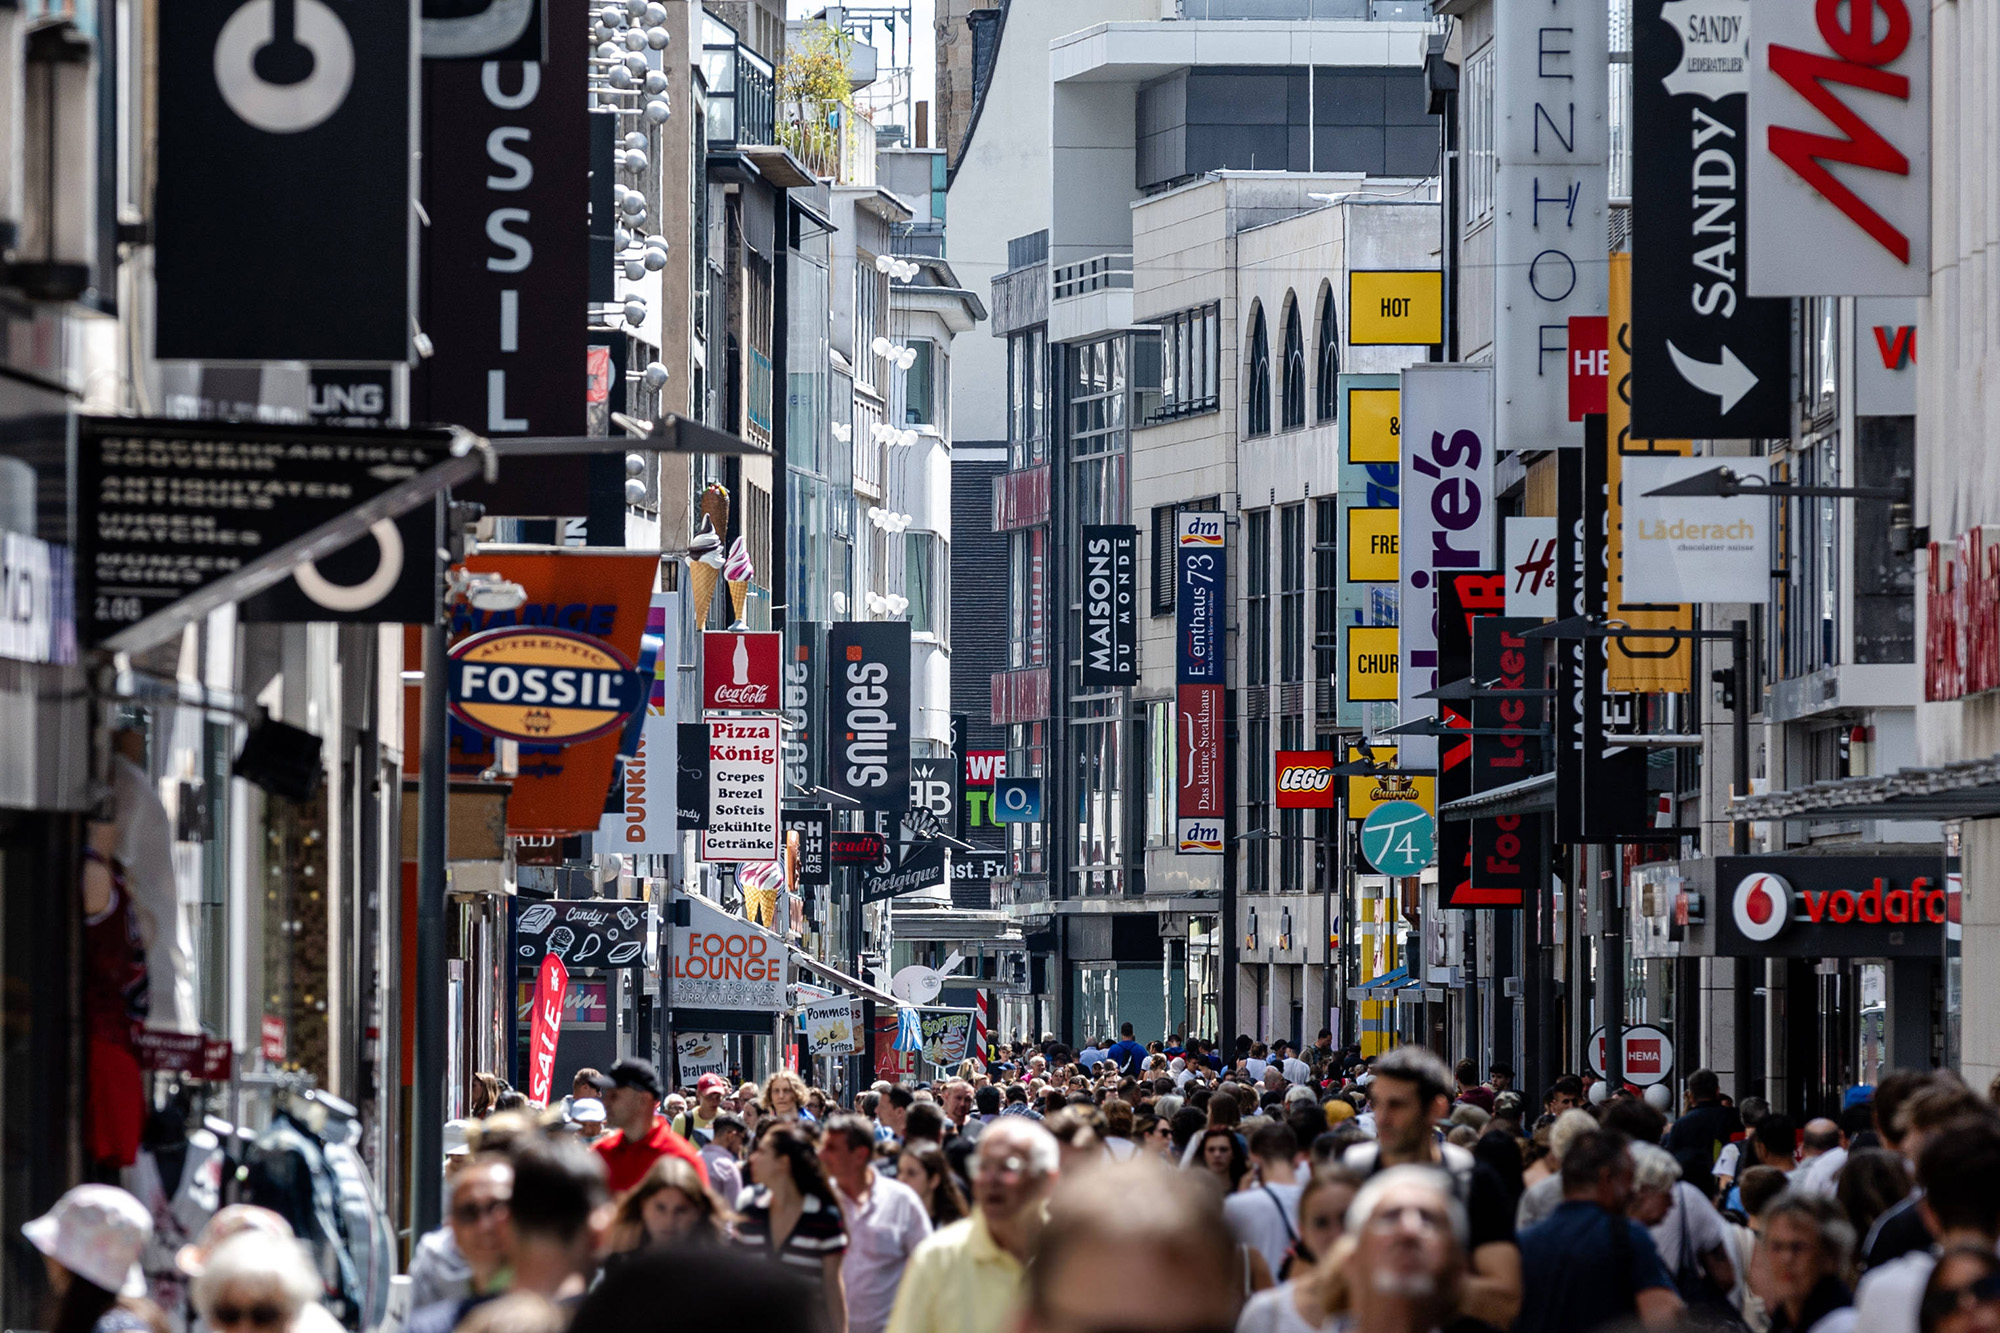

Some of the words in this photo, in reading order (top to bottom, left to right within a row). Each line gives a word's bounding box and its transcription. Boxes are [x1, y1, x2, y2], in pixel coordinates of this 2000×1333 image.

[1688, 14, 1742, 43] SANDY
[1687, 57, 1744, 73] LEDERATELIER
[1529, 27, 1581, 376] ENHOF
[1692, 107, 1737, 318] SANDY
[1380, 298, 1411, 318] HOT
[1574, 350, 1609, 376] HE
[1188, 517, 1219, 535] dm
[1638, 518, 1755, 540] Läderach
[1371, 535, 1399, 554] FRE
[1186, 554, 1215, 586] 73
[1514, 538, 1556, 596] H&
[1118, 538, 1131, 624] MONDE
[1088, 538, 1111, 672] MAISONS
[1188, 586, 1206, 676] Eventhaus
[1118, 645, 1130, 673] DU
[1357, 653, 1399, 674] CHUR
[460, 665, 622, 707] FOSSIL
[714, 684, 769, 704] Coca-Cola
[846, 662, 898, 788] snipes
[1198, 689, 1209, 748] Steakhaus
[712, 723, 771, 739] Pizza
[709, 745, 775, 765] König
[716, 771, 766, 784] Crepes
[1198, 750, 1209, 787] kleine
[1280, 768, 1331, 791] LEGO
[718, 788, 764, 799] Brezel
[1198, 787, 1209, 811] Das
[715, 805, 765, 816] Softeis
[708, 821, 772, 835] gekühlte
[1187, 822, 1218, 841] dm
[707, 838, 775, 849] Getränke
[1486, 813, 1521, 875] Foo
[869, 864, 941, 896] Belgique
[566, 906, 609, 928] Candy!
[689, 932, 768, 958] FOOD
[674, 955, 781, 982] LOUNGE
[807, 1006, 851, 1021] Pommes
[829, 1030, 838, 1040] €
[921, 1014, 969, 1038] SOFTEIS
[830, 1042, 853, 1054] Frites
[875, 1043, 915, 1075] ALE
[1627, 1050, 1661, 1062] HEMA
[682, 1061, 724, 1078] Bratwurst
